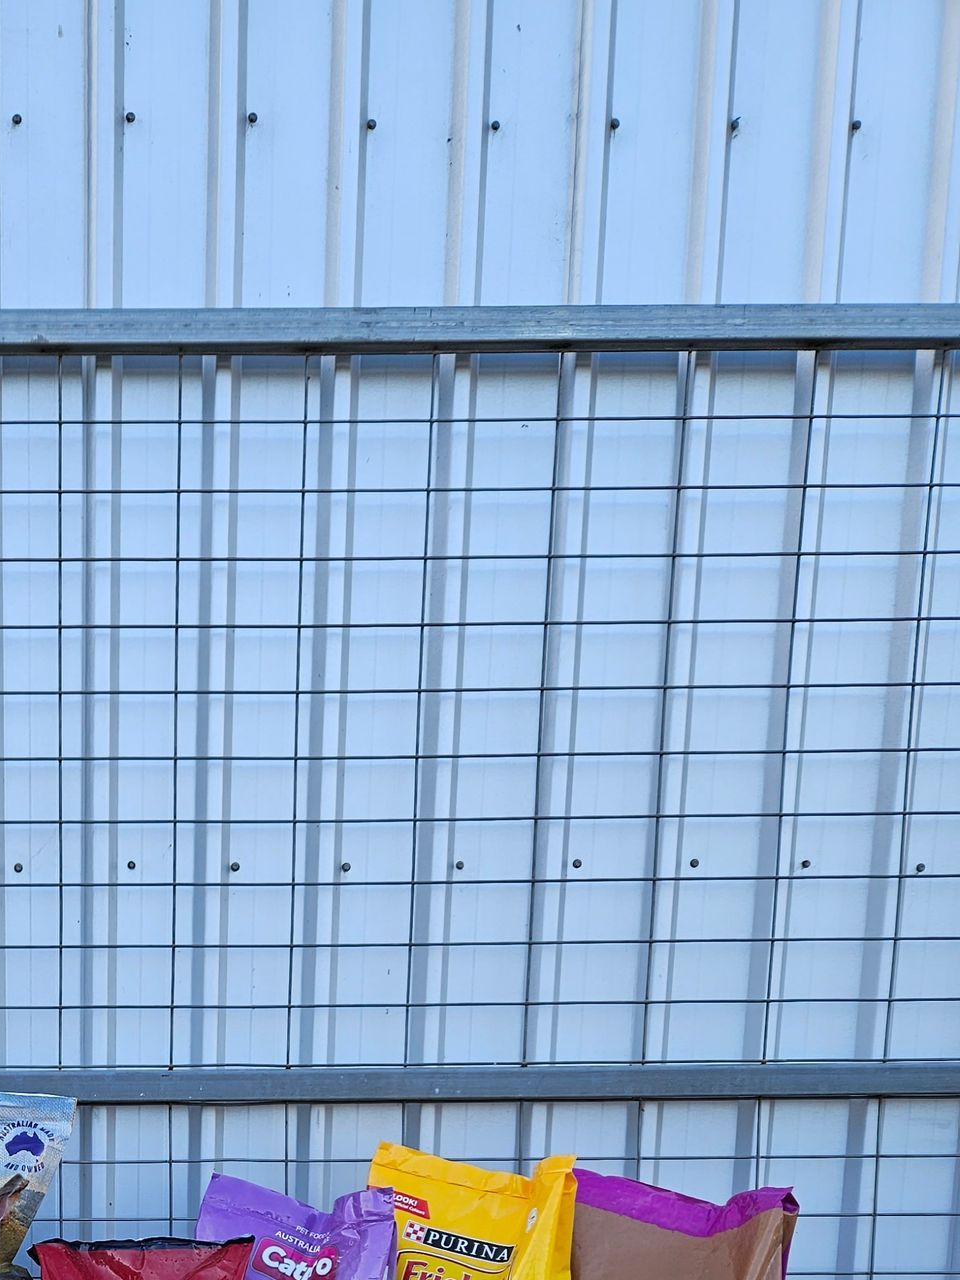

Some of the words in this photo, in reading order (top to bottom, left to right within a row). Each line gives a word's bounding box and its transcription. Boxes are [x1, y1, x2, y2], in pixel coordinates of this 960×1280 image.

[4, 1162, 19, 1171] AND
[274, 1230, 321, 1253] AUSTRALIA
[426, 1230, 509, 1261] PURINA
